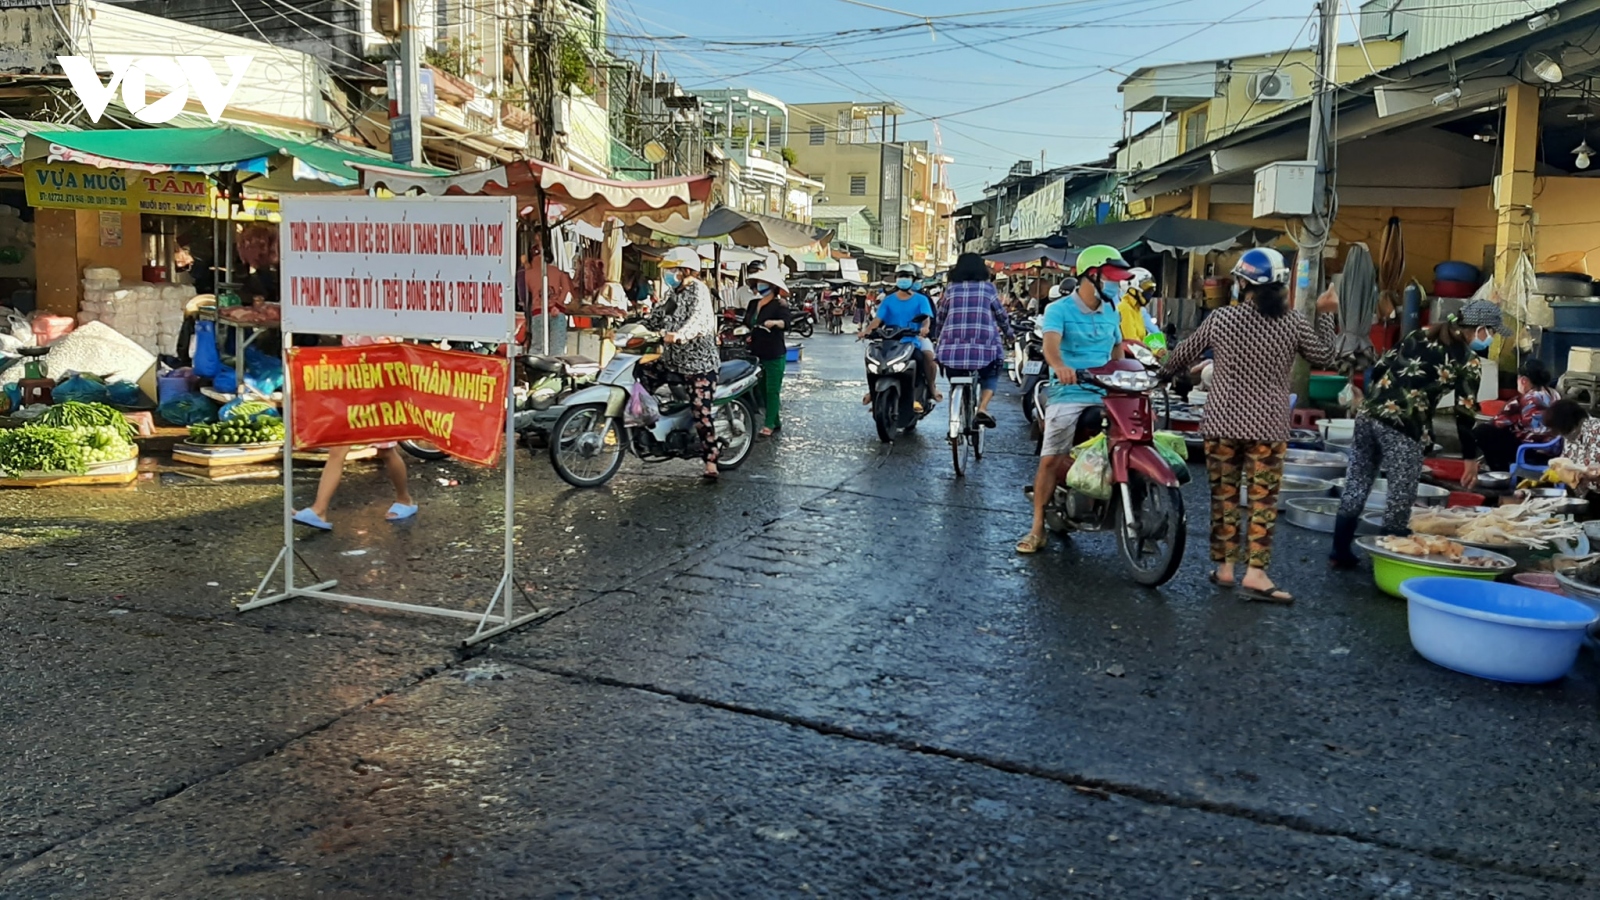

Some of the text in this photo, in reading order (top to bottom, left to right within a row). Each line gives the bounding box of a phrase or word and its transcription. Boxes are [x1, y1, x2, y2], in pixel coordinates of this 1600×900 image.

[36, 168, 126, 191] VỰA MUỐI
[143, 176, 205, 195] TÂM
[290, 210, 503, 264] THỰC HIỆN NGHIÊM VIỆC ĐEO KHẨU TRANG KHI RA, VÀO CHỢ
[291, 276, 298, 306] VI
[301, 276, 321, 314] PHẠM
[324, 277, 342, 314] PHẠT
[363, 271, 373, 309] TỪ
[375, 279, 379, 309] 1
[382, 272, 403, 317] TRIỆU
[406, 268, 426, 311] ĐỒNG
[430, 269, 445, 311] ĐẾN
[449, 281, 453, 312] 3
[457, 274, 478, 320] TRIỆU
[482, 270, 503, 314] ĐỒNG
[303, 353, 497, 411] ĐIỂM KIỂM TR THÂN NHIỆT
[347, 403, 380, 429] KHI
[380, 400, 407, 426] RA
[424, 409, 455, 447] CHỢ
